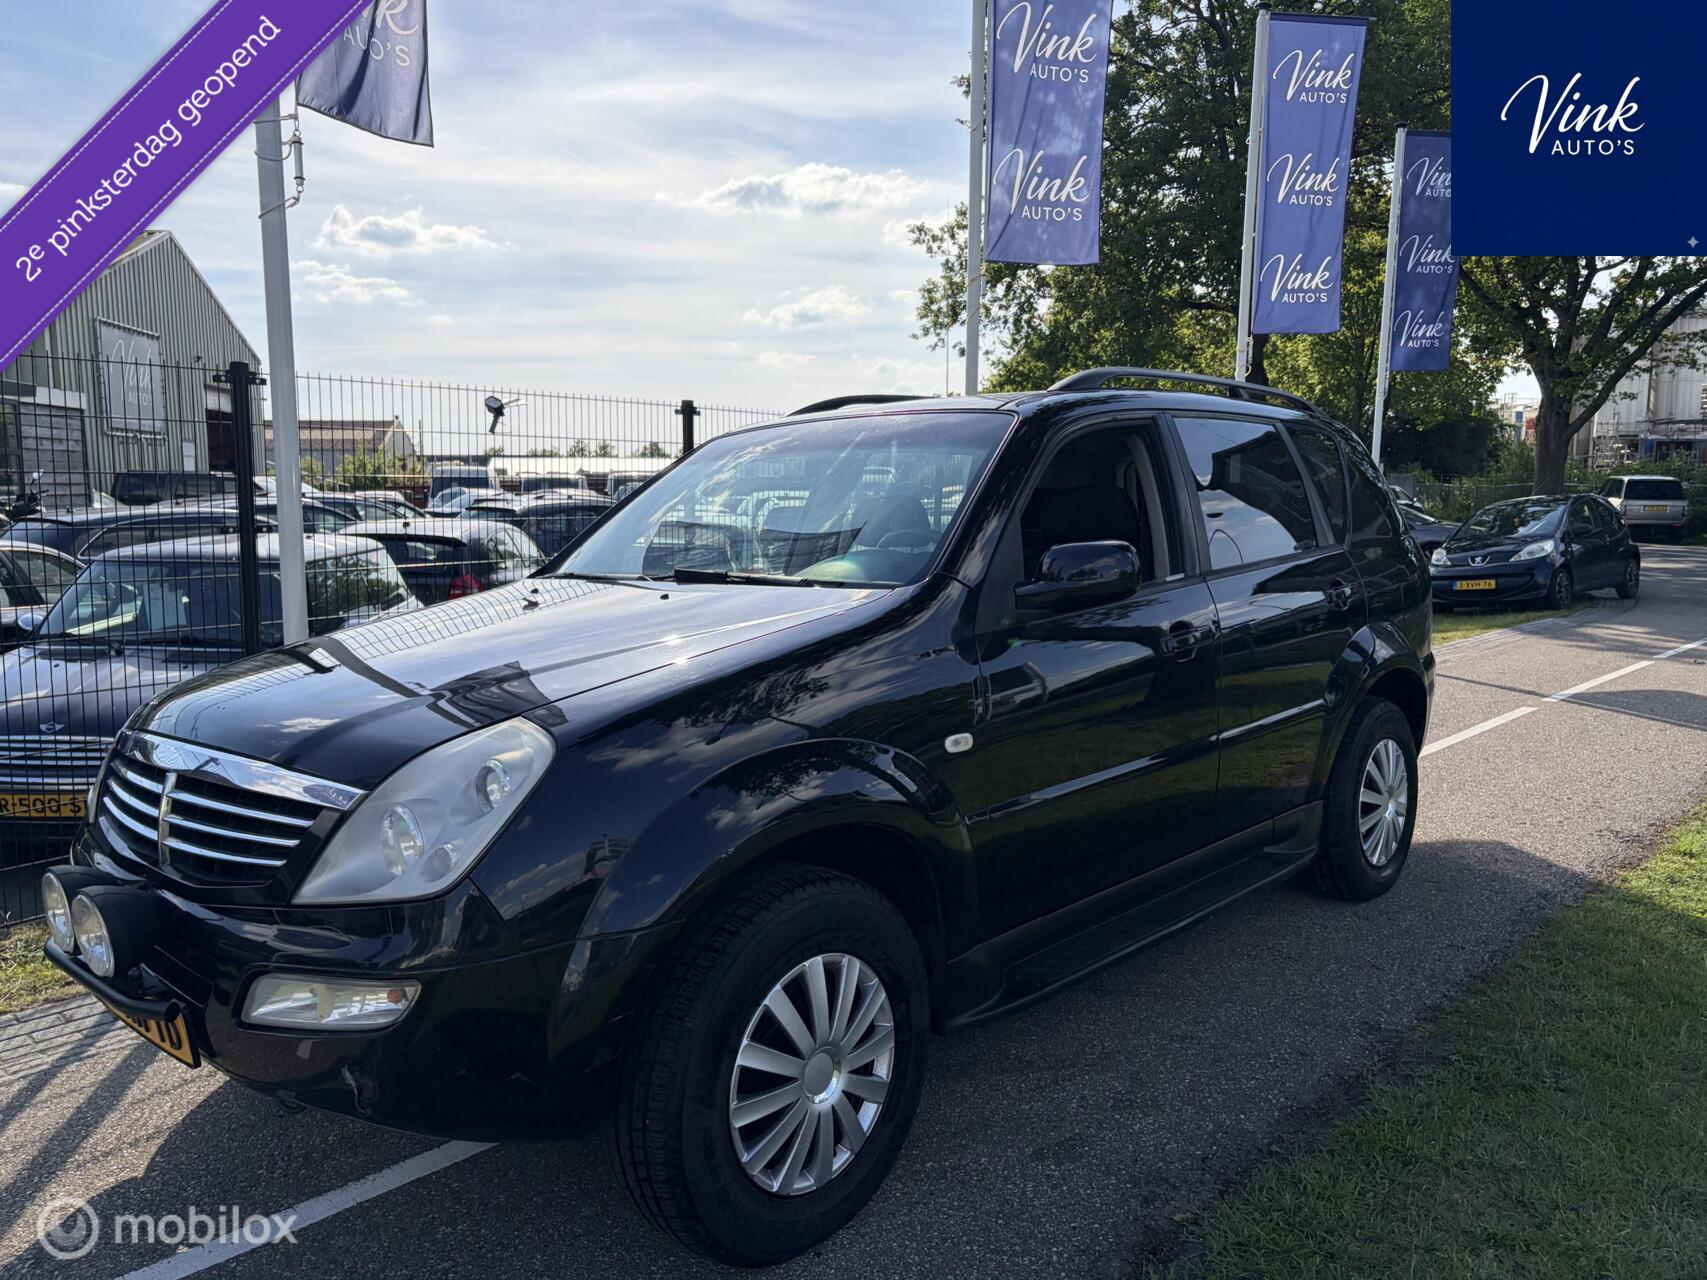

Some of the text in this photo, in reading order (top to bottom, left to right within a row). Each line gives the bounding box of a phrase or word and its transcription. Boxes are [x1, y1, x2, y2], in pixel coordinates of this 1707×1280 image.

[343, 24, 410, 67] AUO'S
[997, 1, 1097, 73] Vink
[1029, 65, 1089, 83] AUTO'S
[1273, 49, 1353, 101] Vink
[1300, 91, 1347, 104] AUTO'S
[993, 148, 1090, 216] Vink
[1266, 153, 1339, 206] Vink
[1406, 157, 1451, 196] Vin
[1021, 207, 1082, 222] AUTO'S
[1289, 195, 1332, 206] AUTO'S
[1400, 234, 1455, 272] Vink
[1416, 265, 1453, 274] AUTO'S
[1260, 253, 1334, 303] Vink
[1281, 293, 1328, 303] AUTO'S
[1394, 310, 1444, 347] Vink
[1407, 339, 1440, 348] AUTO'S
